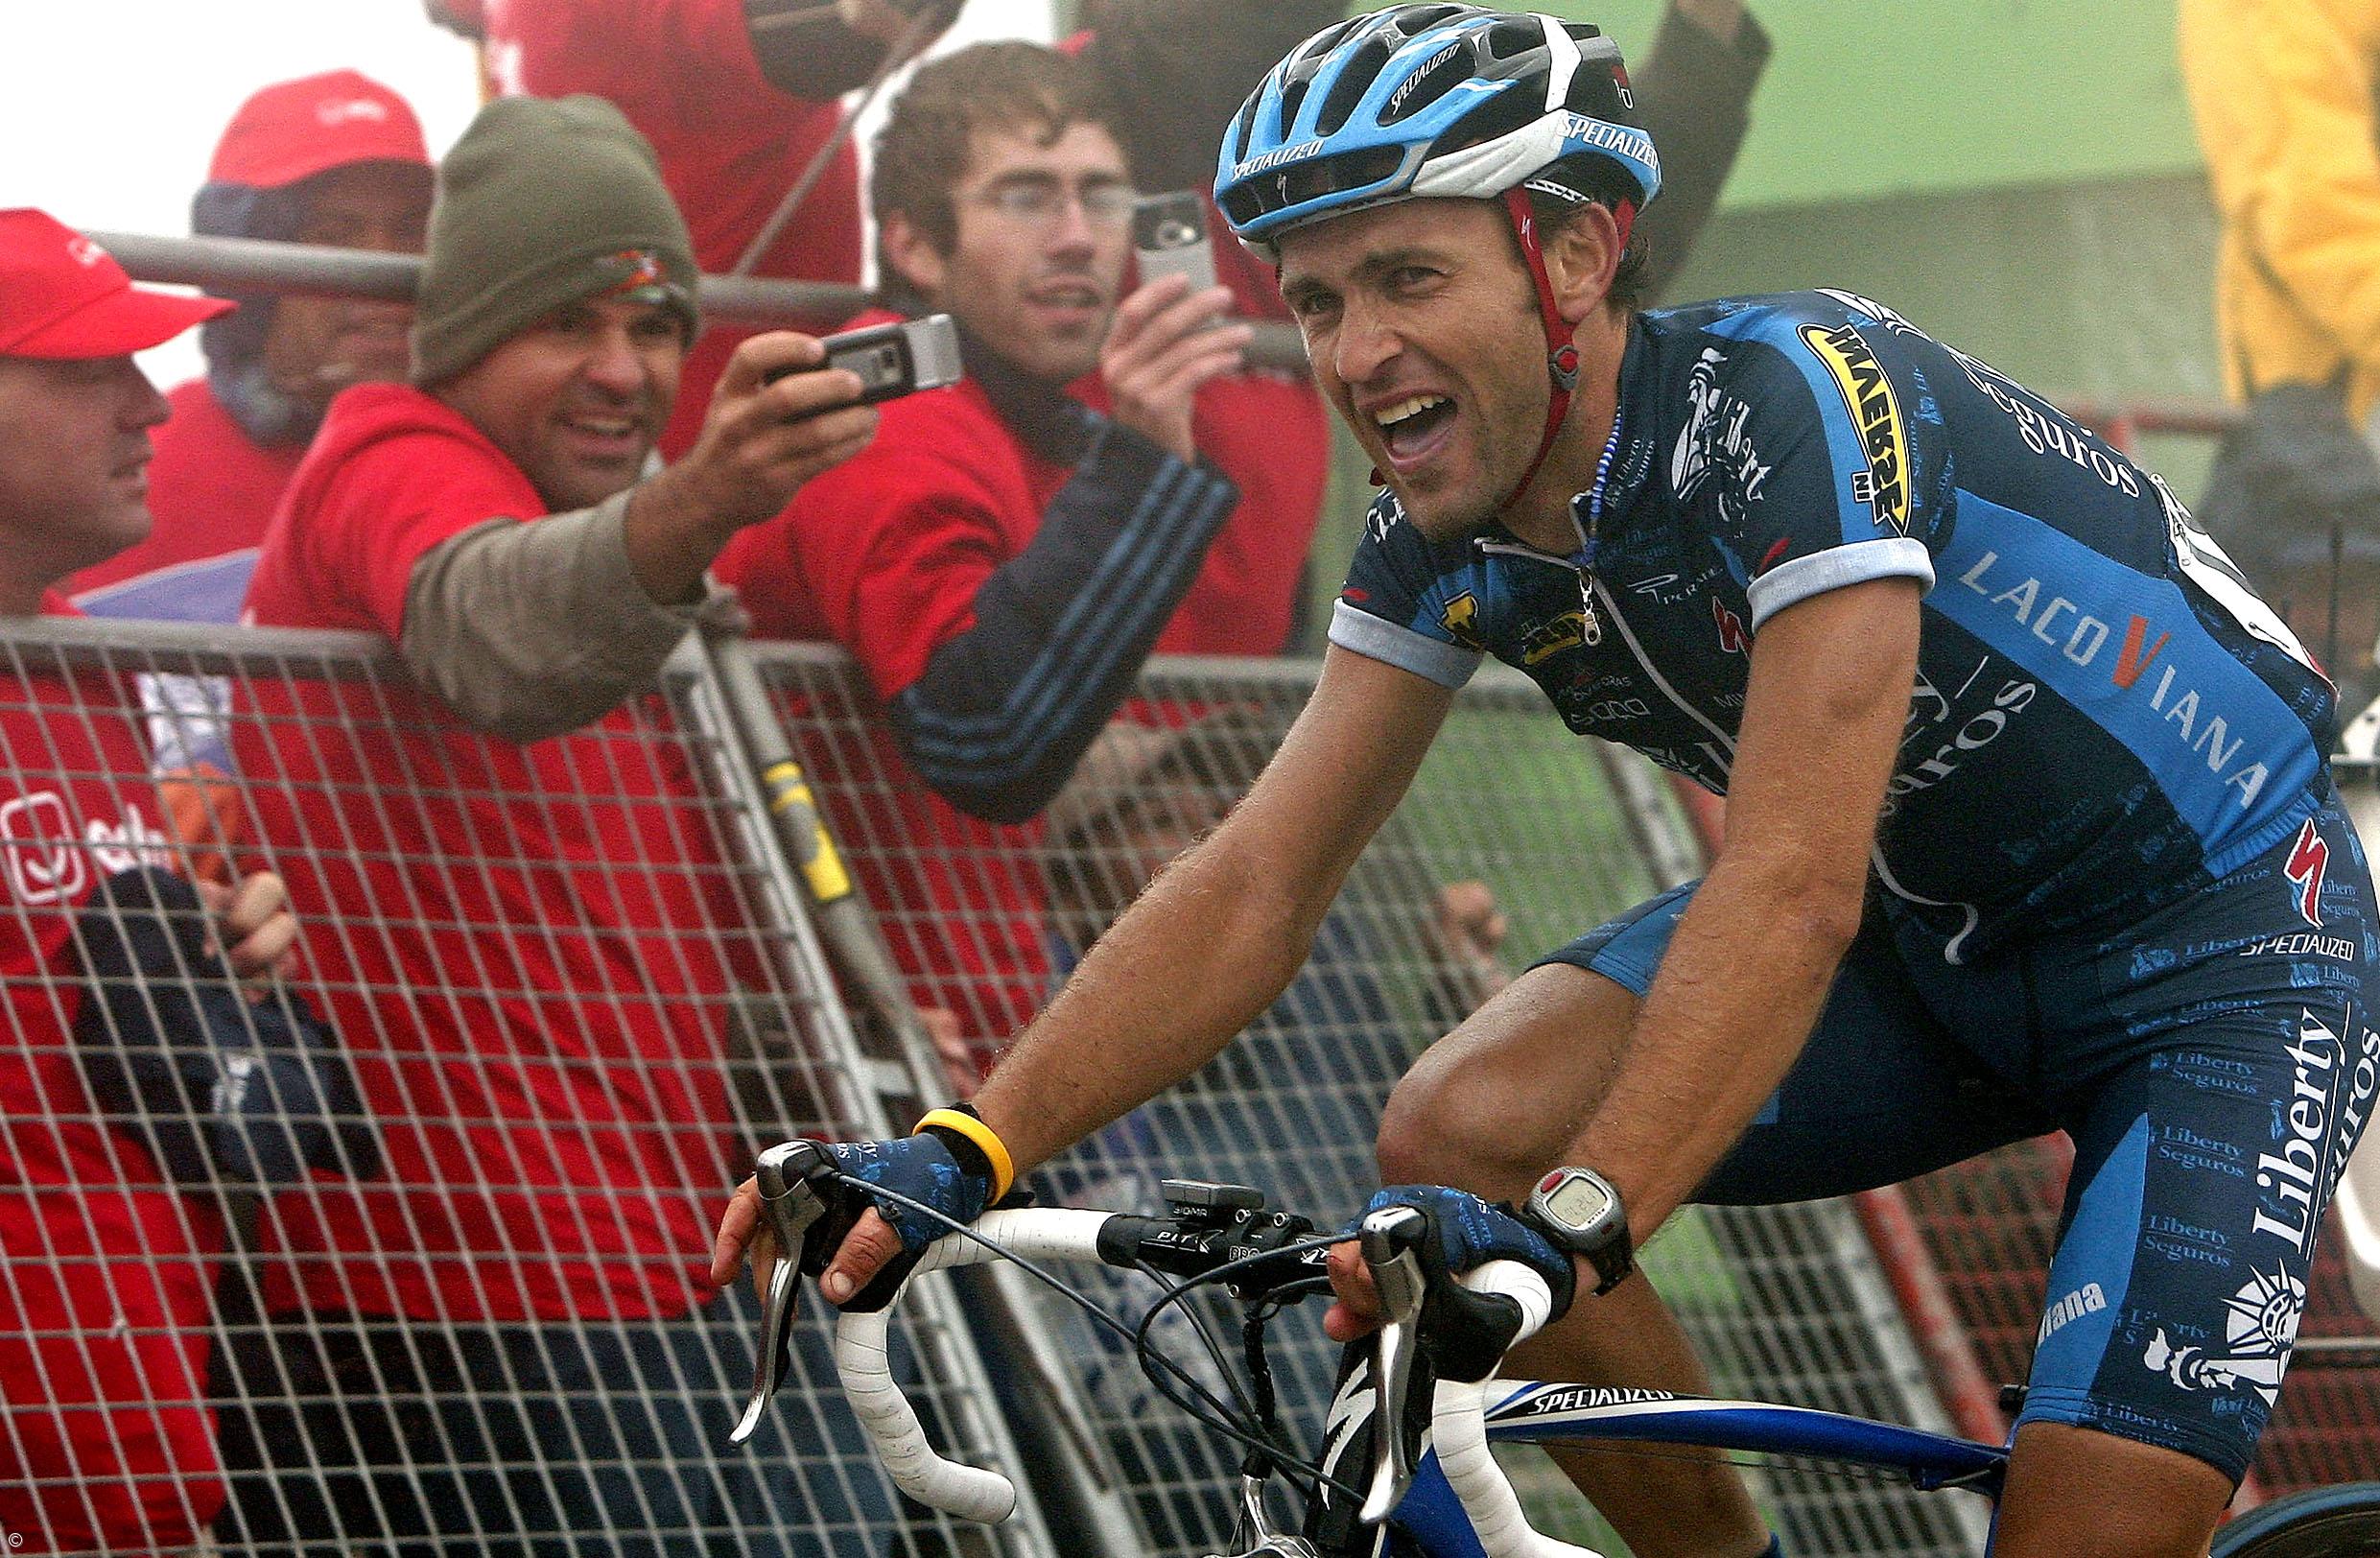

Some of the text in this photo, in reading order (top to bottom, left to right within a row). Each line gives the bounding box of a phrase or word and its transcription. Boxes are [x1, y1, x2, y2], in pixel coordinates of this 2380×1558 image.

[1390, 42, 1461, 116] SPECIALIZED
[1556, 112, 1661, 170] SPECIALIZED
[1231, 139, 1325, 181] SPECIALIZED
[1961, 552, 2271, 810] LACOVIANA
[1879, 679, 2038, 818] uros
[2239, 933, 2356, 961] SPECIALIZED
[2173, 1066, 2257, 1096] Seguros
[2176, 1052, 2253, 1076] Liberty
[2163, 1124, 2243, 1159] Liberty
[2252, 1007, 2347, 1255] Liberty
[2158, 1145, 2246, 1179] Seguros
[2148, 1214, 2229, 1247] Liberty
[2144, 1234, 2232, 1268] Seguros
[1534, 1386, 1675, 1414] SPECIALIZED
